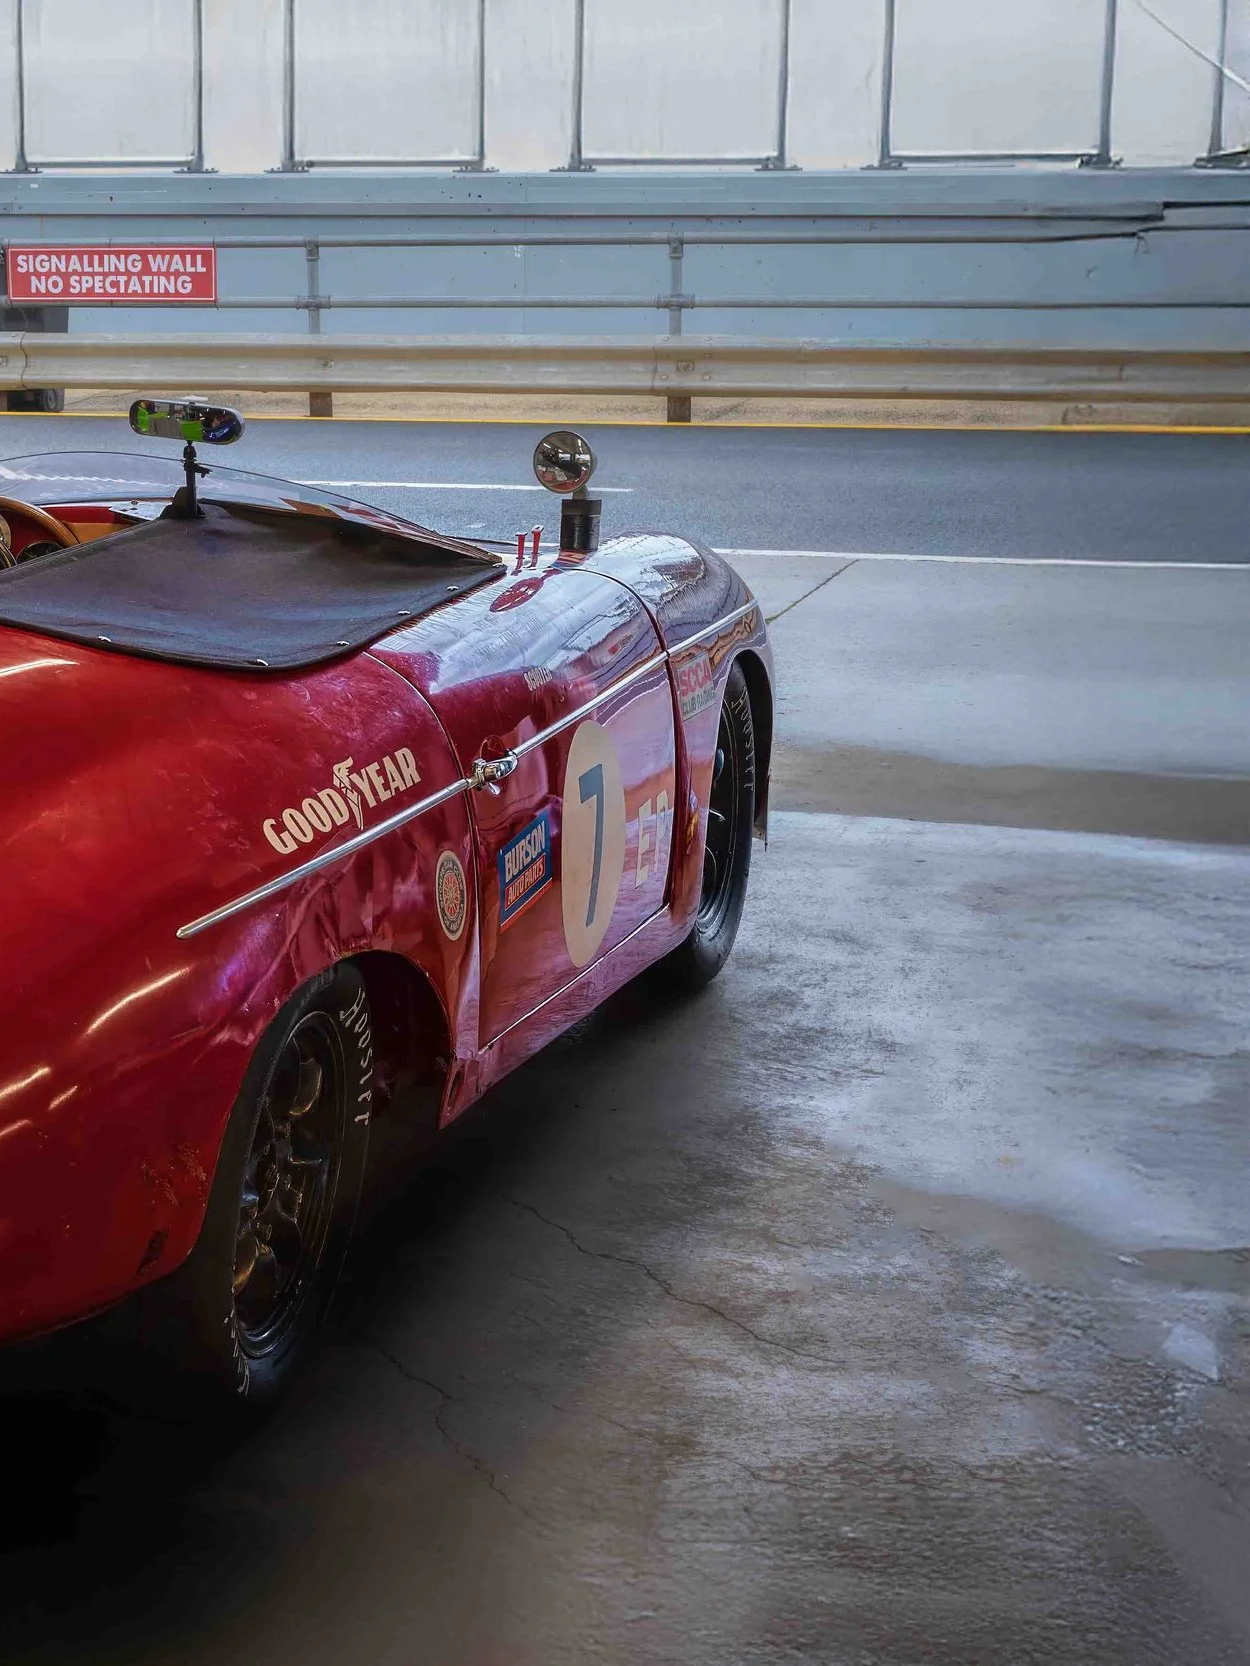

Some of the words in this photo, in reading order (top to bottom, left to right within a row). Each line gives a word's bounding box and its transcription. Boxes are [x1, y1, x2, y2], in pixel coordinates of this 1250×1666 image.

[17, 254, 142, 273] SIGNALLING
[147, 254, 207, 273] WALL
[30, 275, 64, 293] NO
[69, 275, 193, 294] SPECTATING
[504, 820, 546, 883] BURSON
[578, 763, 605, 928] 7
